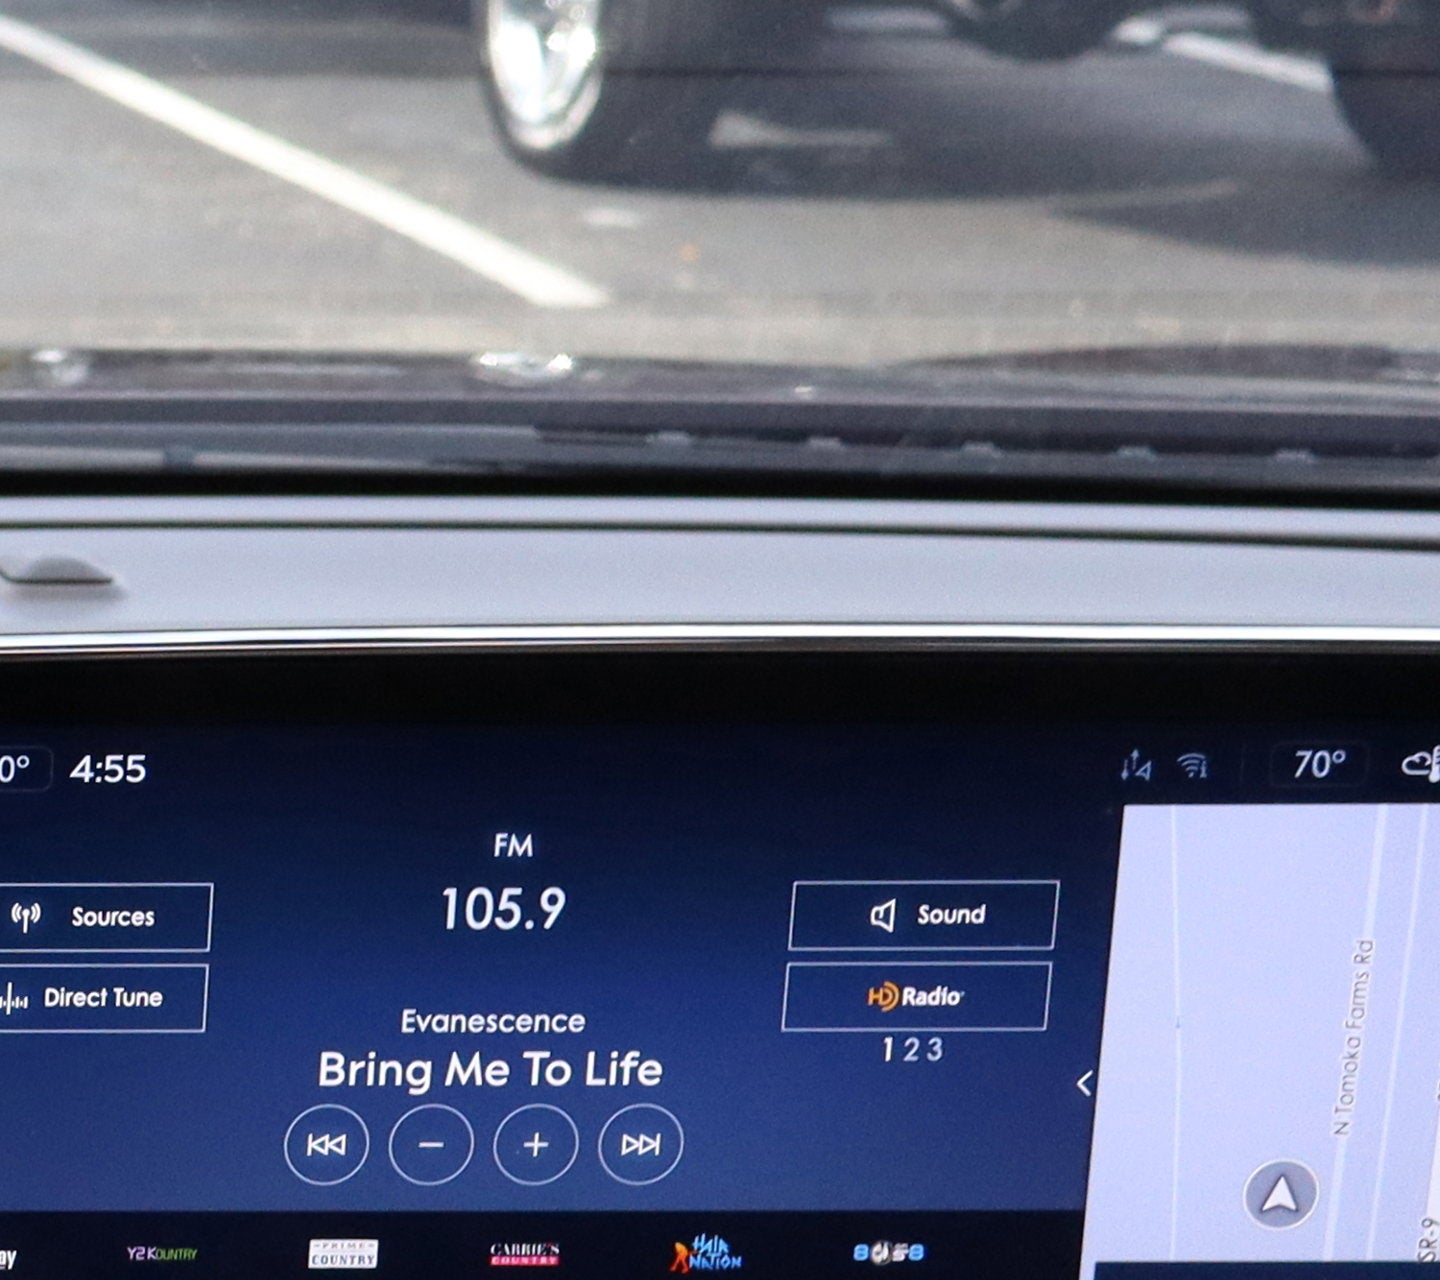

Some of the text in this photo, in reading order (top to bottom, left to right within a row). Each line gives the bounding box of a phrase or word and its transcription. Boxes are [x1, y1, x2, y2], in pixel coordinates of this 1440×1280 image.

[69, 754, 147, 784] 4:55
[1294, 749, 1347, 779] 70°
[493, 832, 535, 858] FM
[70, 906, 156, 928] Sources
[441, 886, 567, 931] 105.9
[916, 903, 987, 926] Sound
[1353, 939, 1374, 964] Rd
[43, 986, 164, 1009] Direct Tune
[1345, 971, 1370, 1030] Farms
[400, 1008, 587, 1034] Evanescence
[317, 1051, 663, 1096] Bring Me To Life
[1334, 1036, 1362, 1115] Tomoka
[321, 1241, 366, 1250] PRIME
[489, 1242, 561, 1256] CARRIE'S
[310, 1254, 375, 1266] COUNTRY
[490, 1256, 559, 1266] COUNTRY
